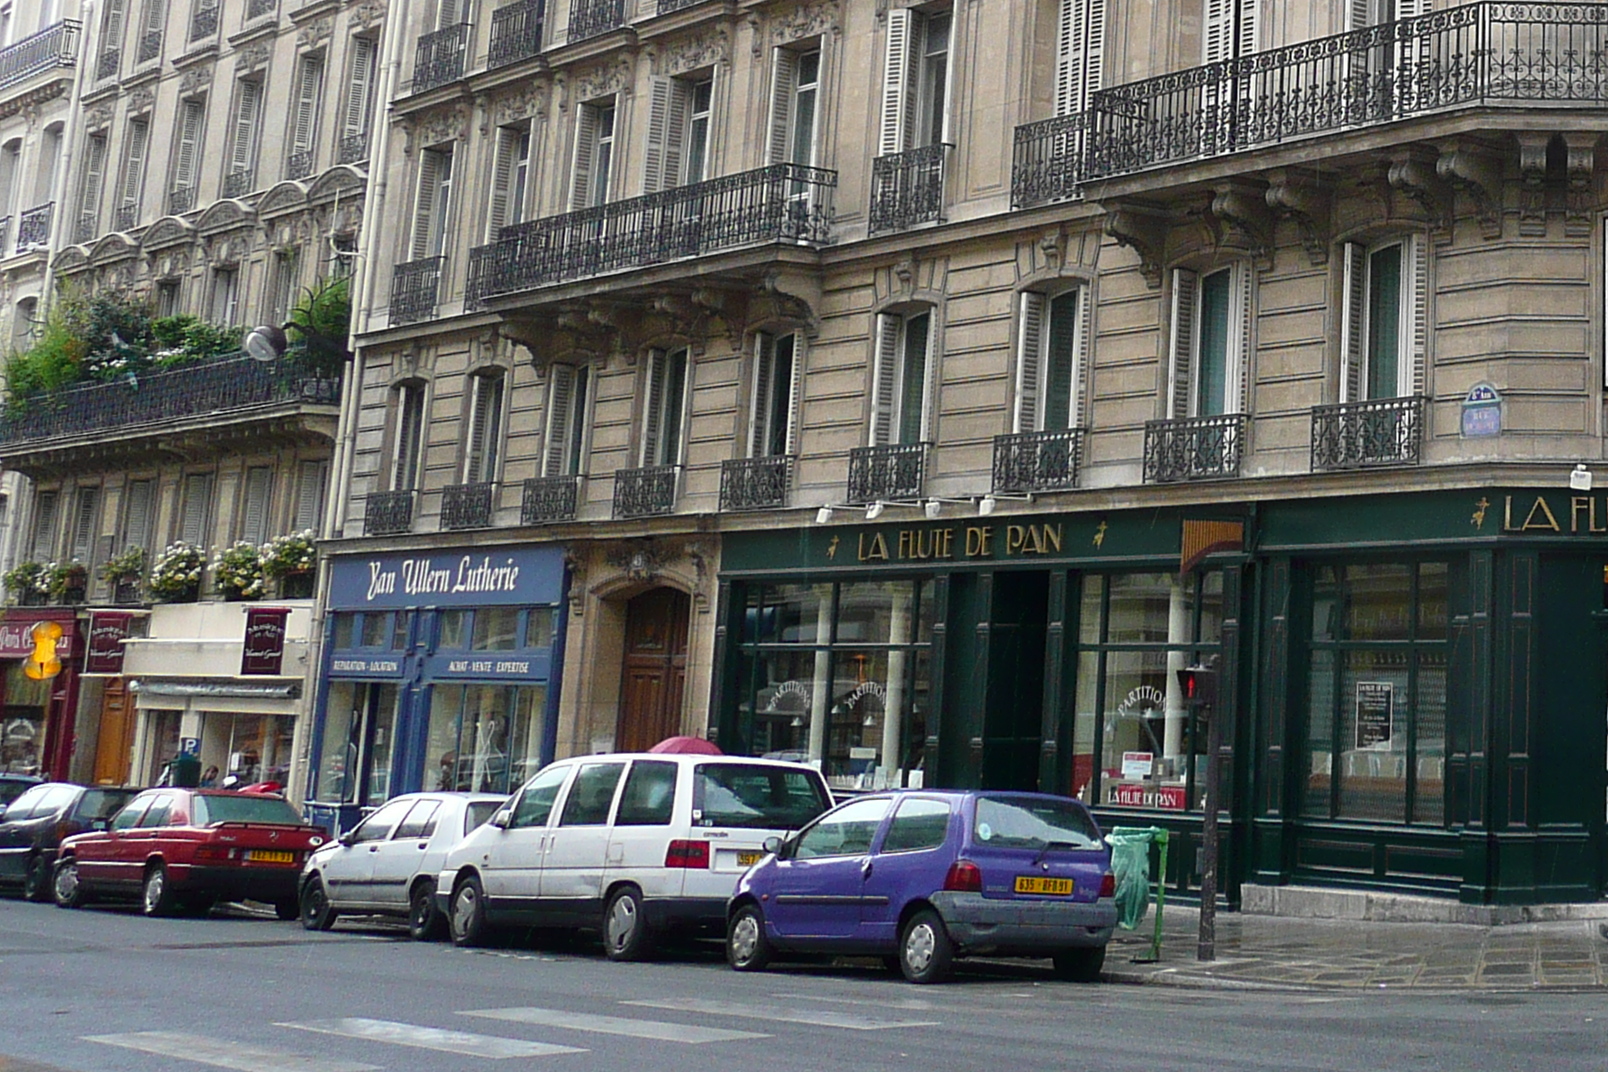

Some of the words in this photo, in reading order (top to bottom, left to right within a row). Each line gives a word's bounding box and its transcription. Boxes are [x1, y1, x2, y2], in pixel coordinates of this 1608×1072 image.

[1504, 495, 1561, 532] LA
[857, 532, 889, 561] LA
[898, 528, 953, 559] FLUTE
[965, 526, 993, 556] DE
[1006, 522, 1062, 555] PAN
[451, 555, 519, 593] Lutherie
[369, 660, 397, 671] LOCATION
[448, 660, 468, 672] ACHAT
[472, 661, 492, 672] VENTE
[496, 661, 529, 673] EXPERTISE
[845, 681, 886, 710] PARTITION
[1118, 685, 1167, 717] PARTITION
[185, 738, 197, 752] P
[1108, 790, 1119, 803] LA
[1155, 793, 1177, 808] PAN
